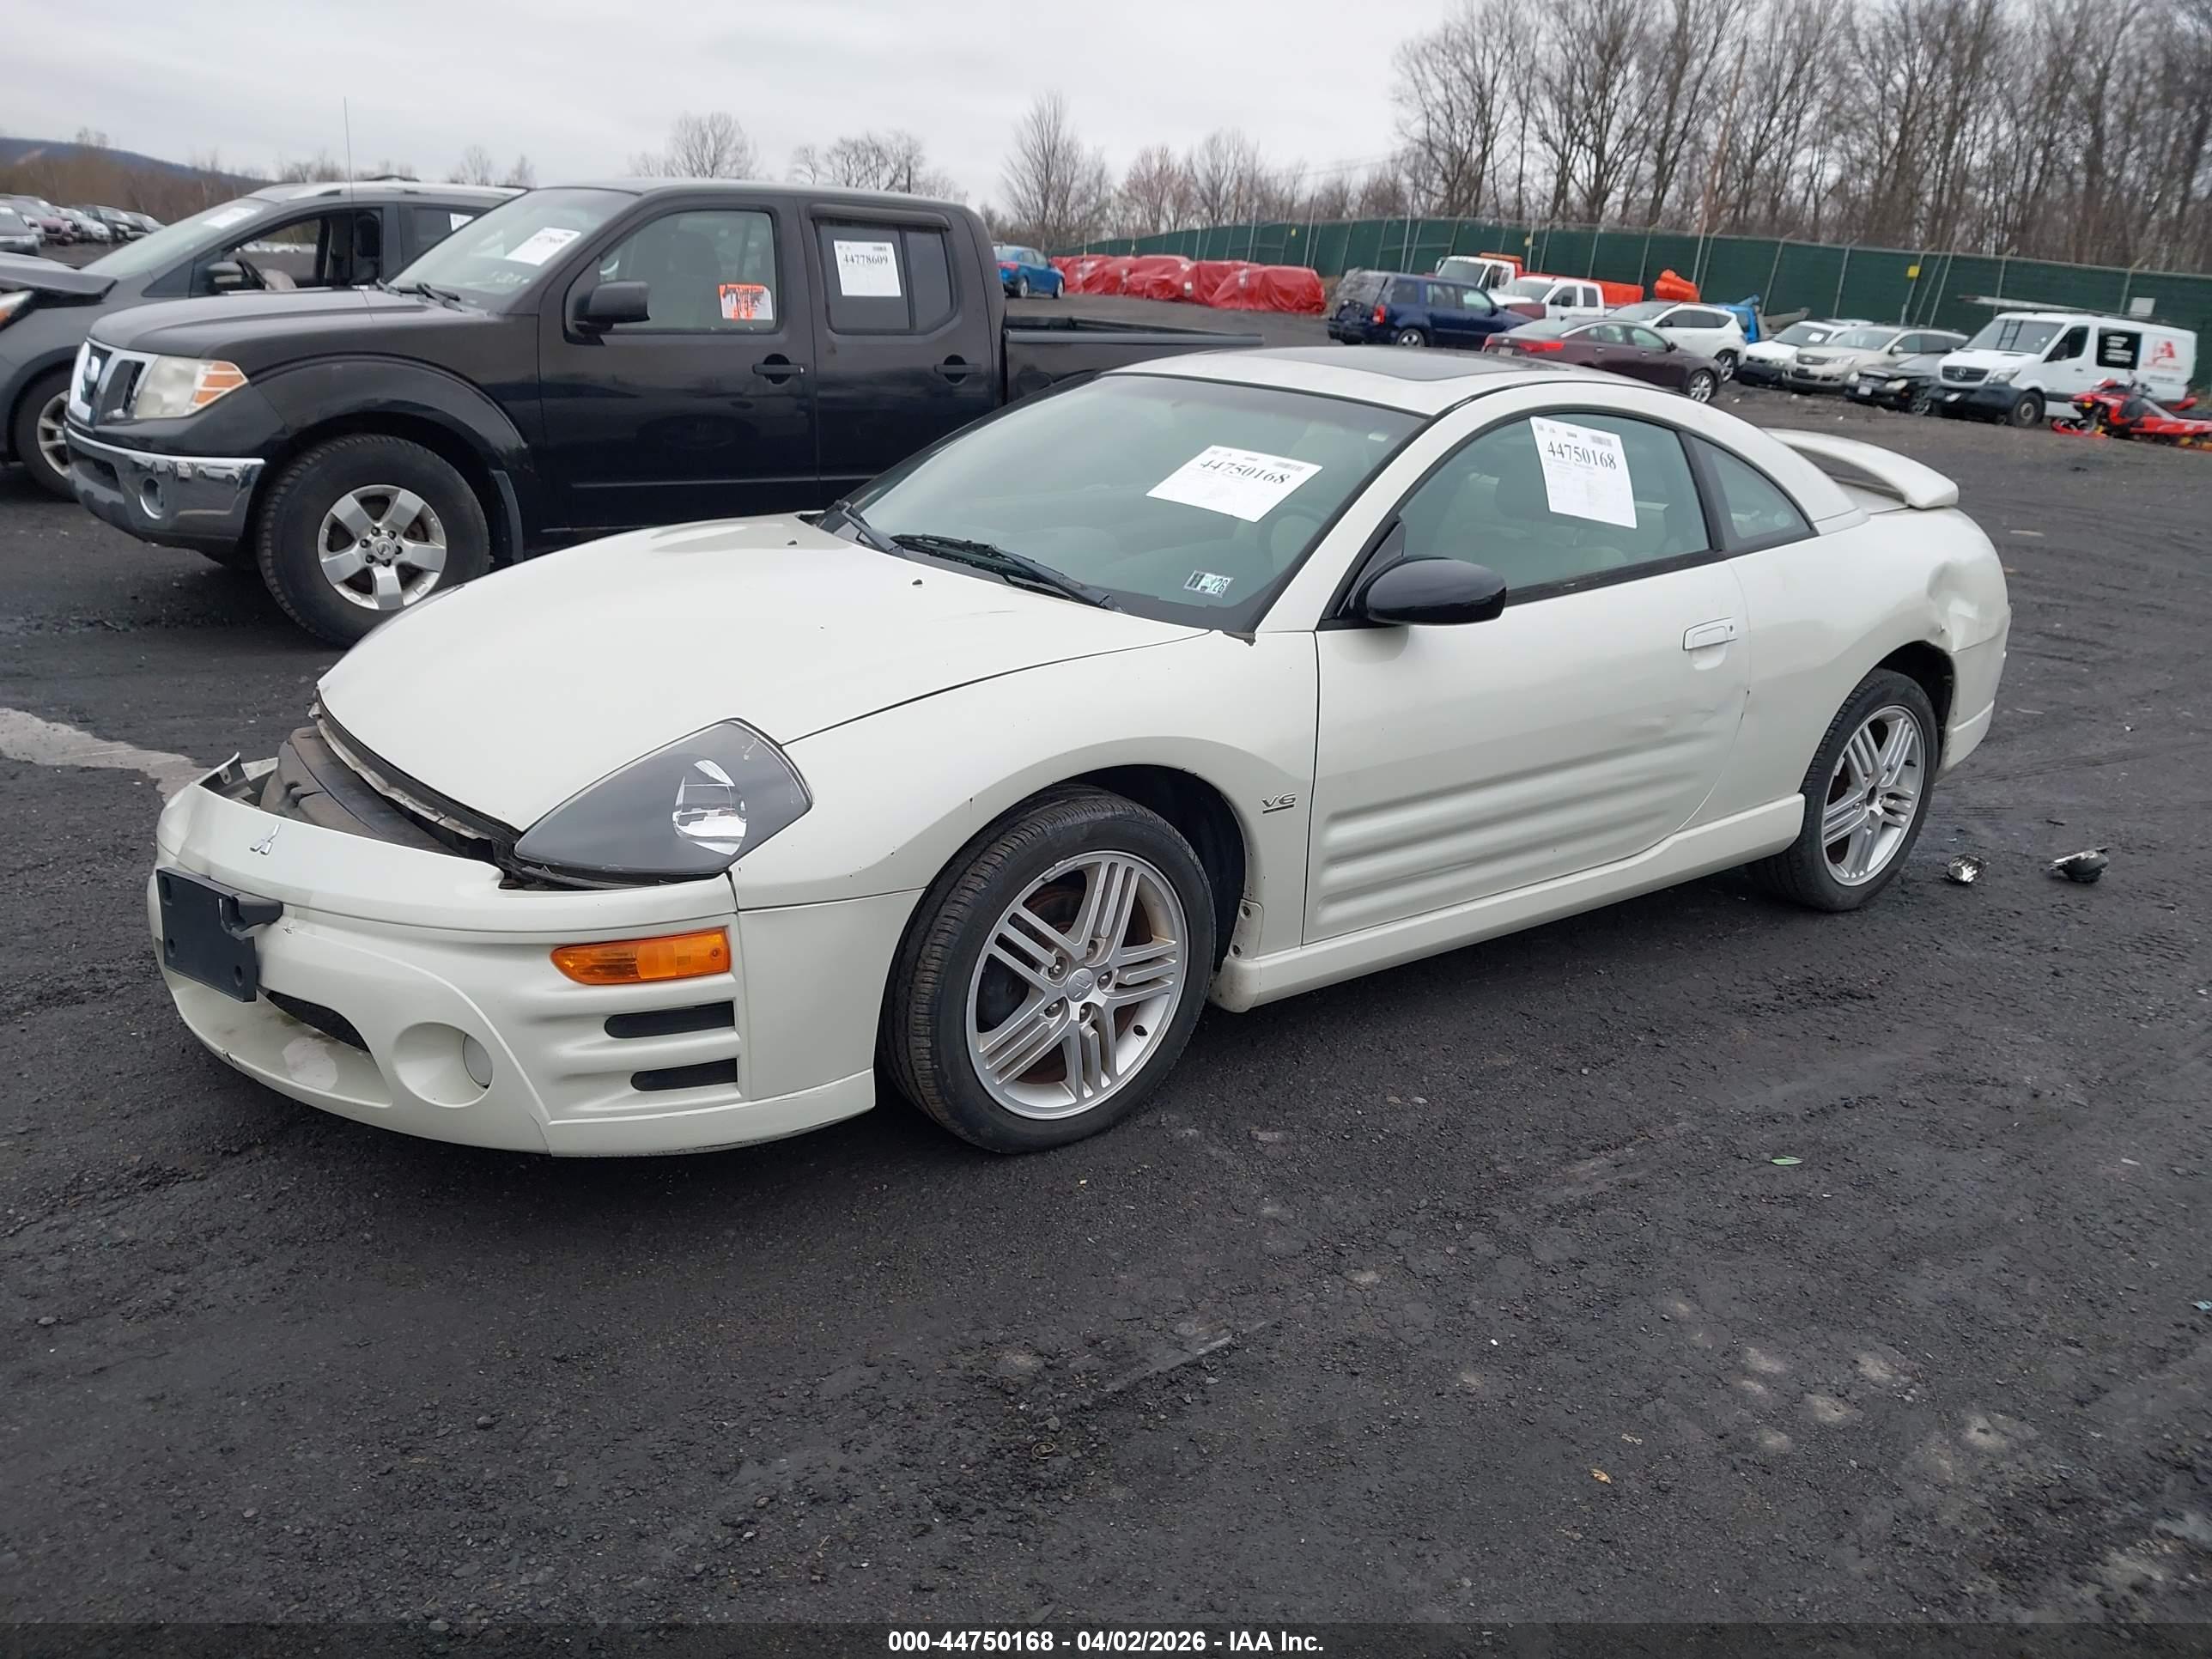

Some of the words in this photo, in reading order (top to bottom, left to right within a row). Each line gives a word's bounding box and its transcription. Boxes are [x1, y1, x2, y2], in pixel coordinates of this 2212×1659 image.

[844, 253, 888, 264] 44778609
[1547, 441, 1617, 470] 44750168
[1200, 459, 1291, 485] 44750168
[1212, 578, 1229, 593] 26
[1261, 793, 1297, 807] V6
